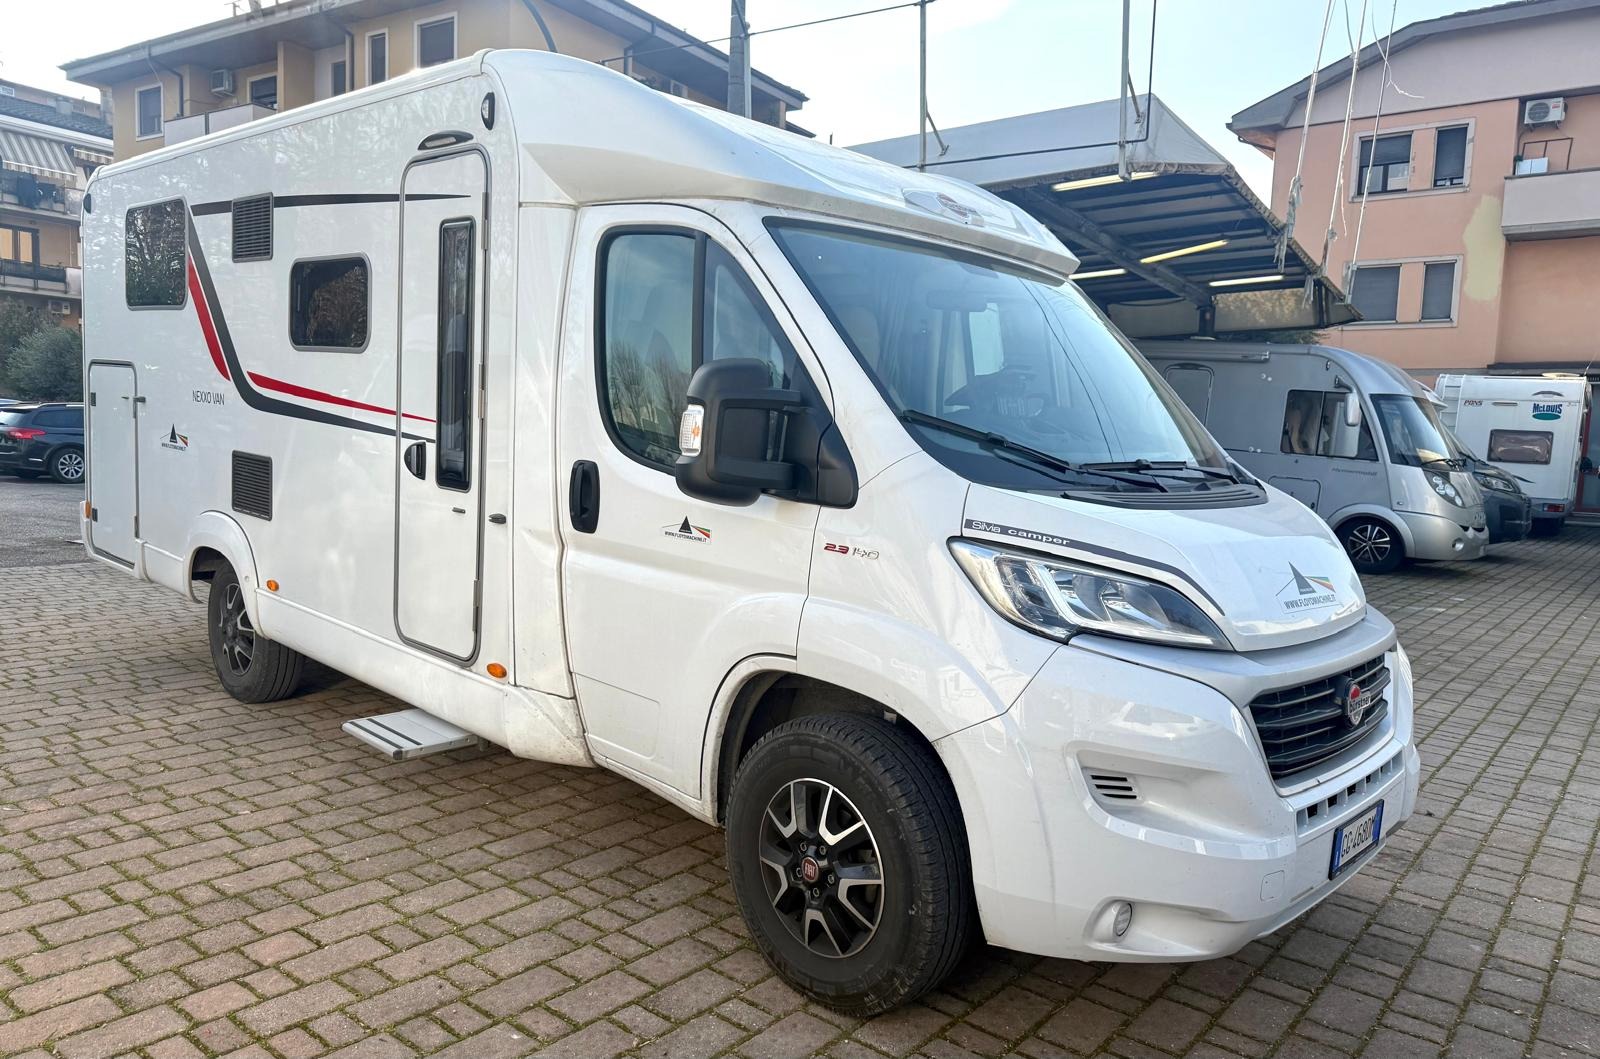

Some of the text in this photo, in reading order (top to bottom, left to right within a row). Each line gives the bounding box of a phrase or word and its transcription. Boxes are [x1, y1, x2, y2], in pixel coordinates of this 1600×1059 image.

[192, 390, 225, 405] NEXXO VAN
[971, 520, 1071, 545] Silvia camper
[804, 862, 816, 879] FIAT
